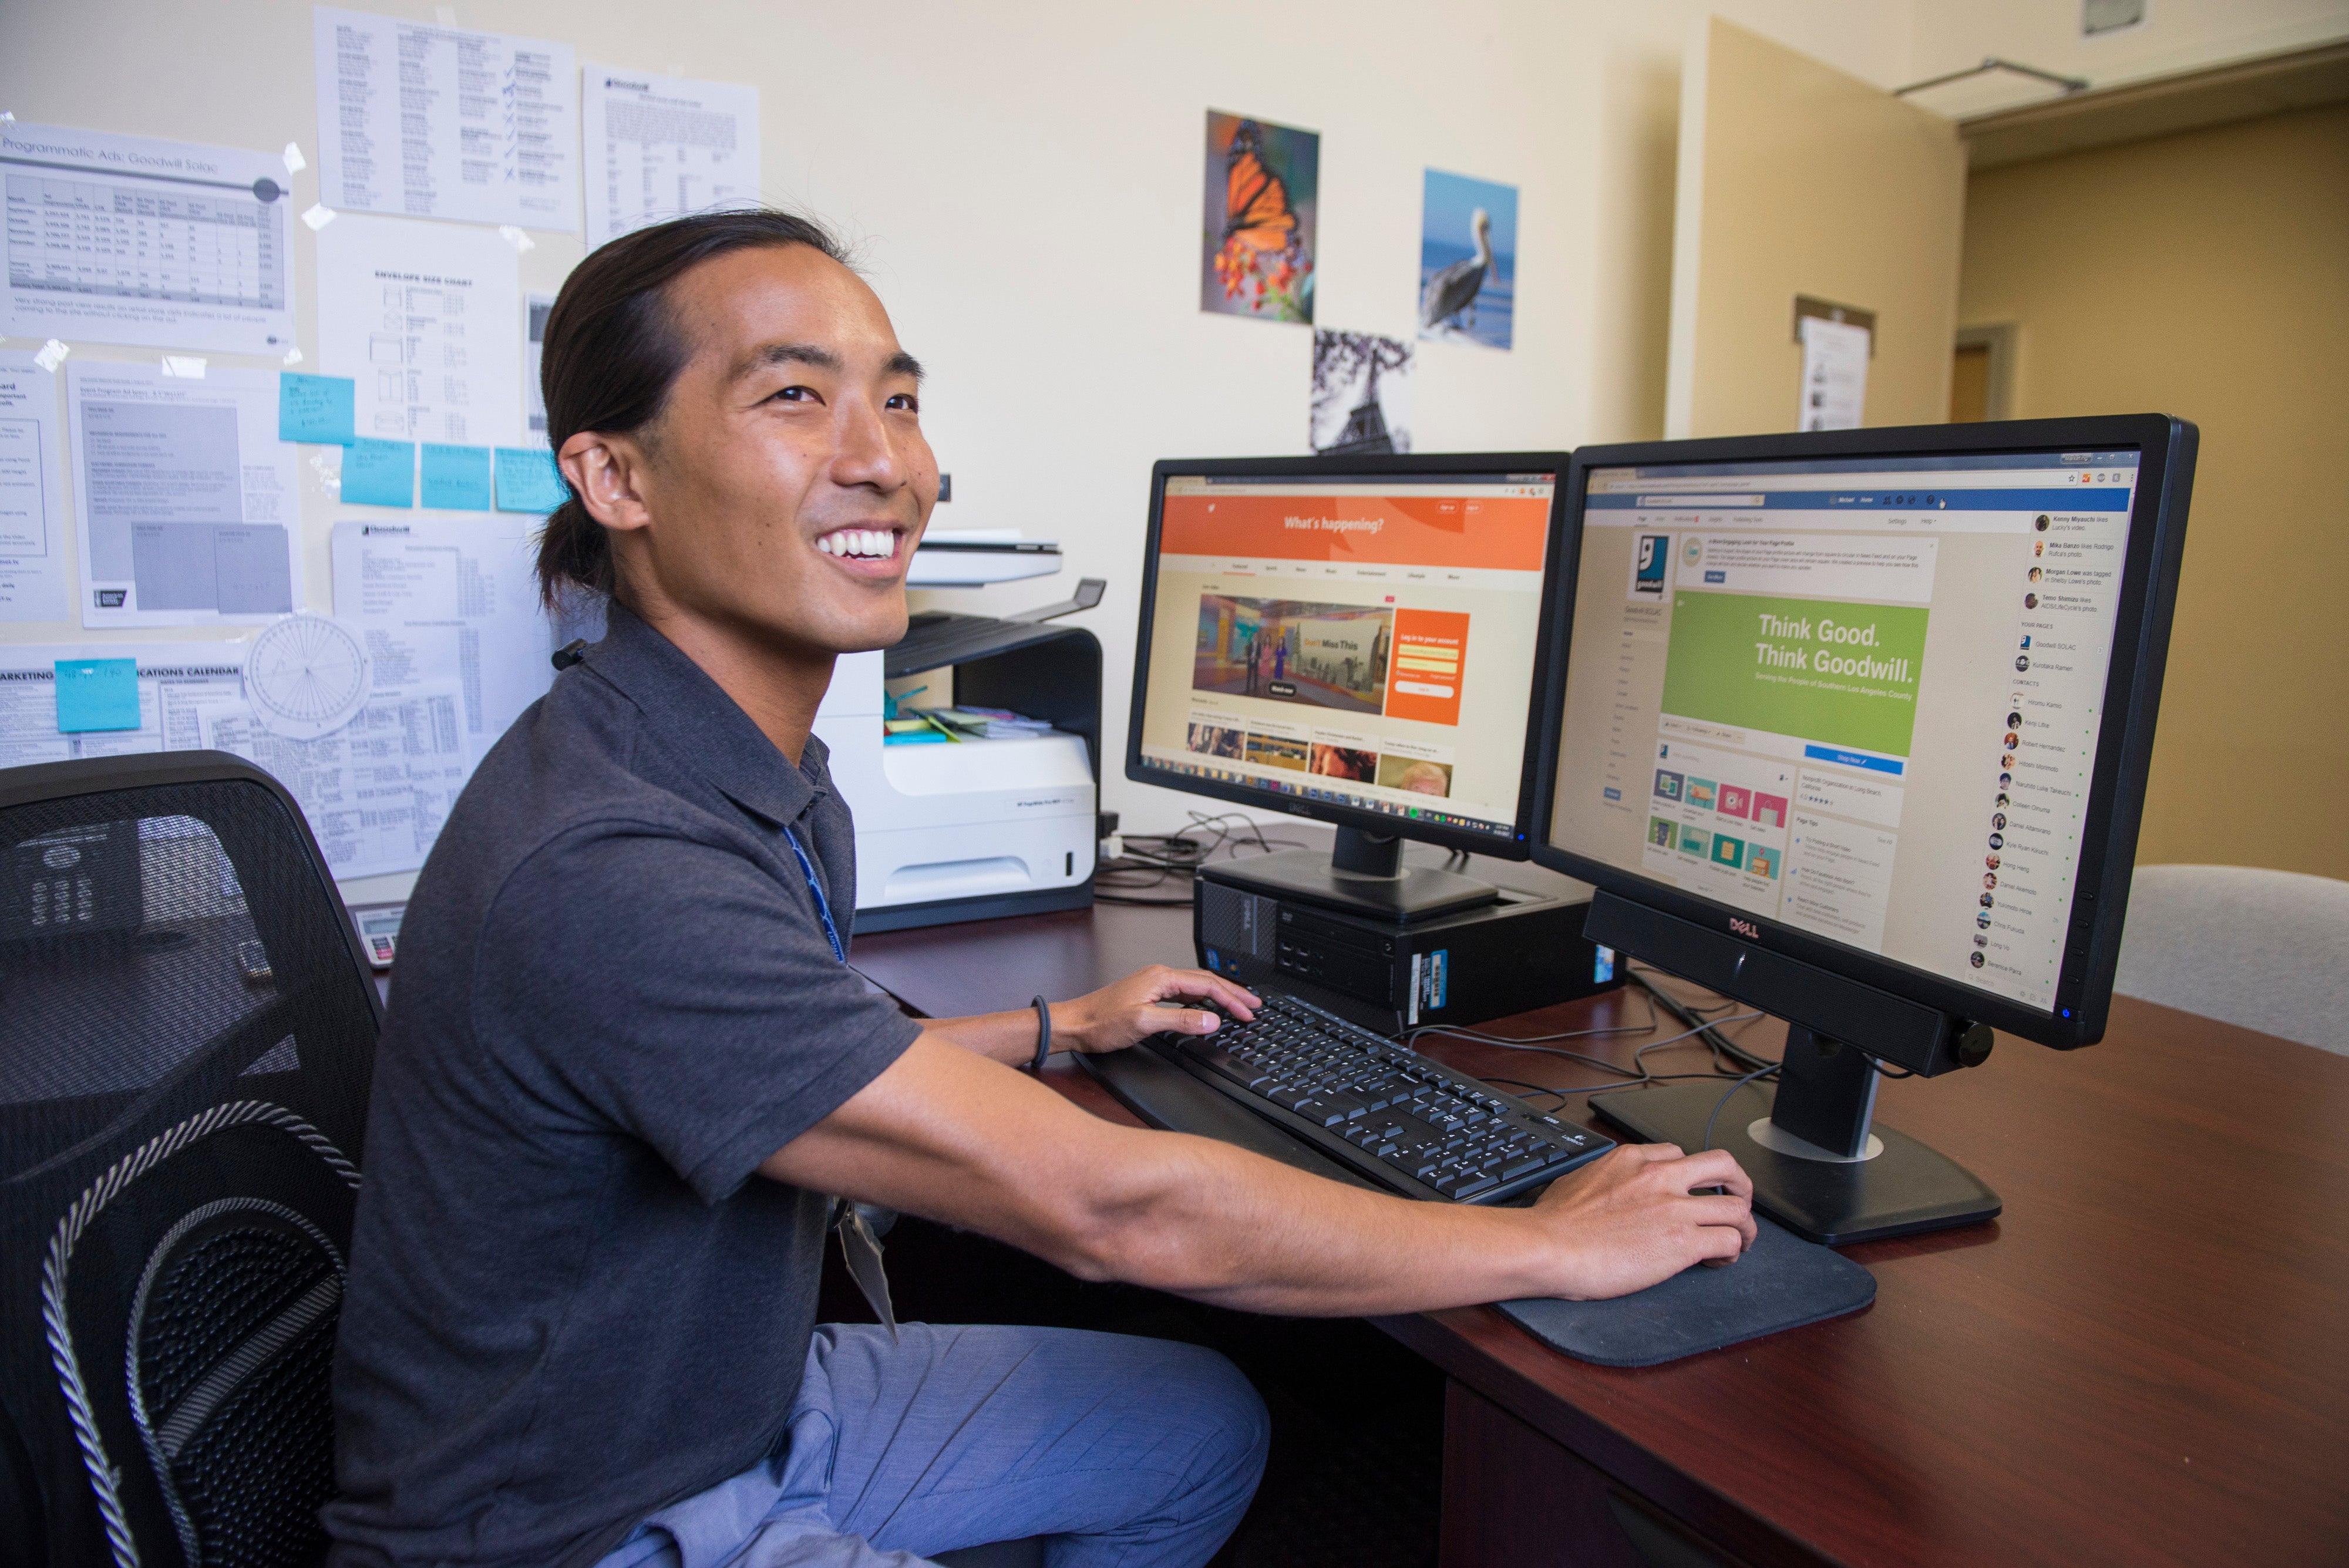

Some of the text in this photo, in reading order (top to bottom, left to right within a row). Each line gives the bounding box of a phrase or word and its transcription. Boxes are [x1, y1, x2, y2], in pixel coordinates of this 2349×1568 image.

[3, 138, 93, 159] Programmatic
[129, 153, 182, 169] Goodwill
[375, 270, 473, 287] ENVELOPE SIZE CHART
[370, 524, 409, 533] Goodwill
[1284, 516, 1384, 534] What's happening?
[1759, 614, 1879, 647] Think Good.
[1401, 634, 1410, 642] Log
[1322, 640, 1338, 648] Miss
[1340, 640, 1358, 650] This
[1756, 642, 1913, 683] Think Goodwill.
[187, 667, 239, 677] CALENDAR
[1756, 672, 1776, 682] Serving
[1789, 676, 1809, 687] People
[1818, 680, 1846, 691] Southern
[1848, 685, 1859, 693] Los
[1860, 686, 1886, 696] Angeles
[1889, 691, 1912, 701] County
[2039, 743, 2065, 752] Hernandez
[1838, 754, 1850, 762] Shop
[2037, 764, 2058, 772] Morimoto
[1802, 783, 1821, 792] California
[1822, 779, 1849, 789] Organization
[1855, 786, 1866, 794] Long
[2016, 781, 2036, 789] Naruhito
[2050, 787, 2071, 796] Takeuchi
[2013, 801, 2030, 809] Colleen
[2025, 825, 2051, 835] Altamirano
[2031, 847, 2048, 856] Kikuchi
[2003, 862, 2030, 873] Hong Heng
[1820, 903, 1839, 913] Customers
[1730, 917, 1759, 938] DELL
[1994, 921, 2025, 934] Chris Fukuda
[1988, 960, 2021, 975] Berenice Parra
[1976, 976, 1994, 987] Search
[1401, 1073, 1418, 1084] Backspace
[1543, 1116, 1560, 1124] K200
[1561, 1135, 1584, 1146] Logitech
